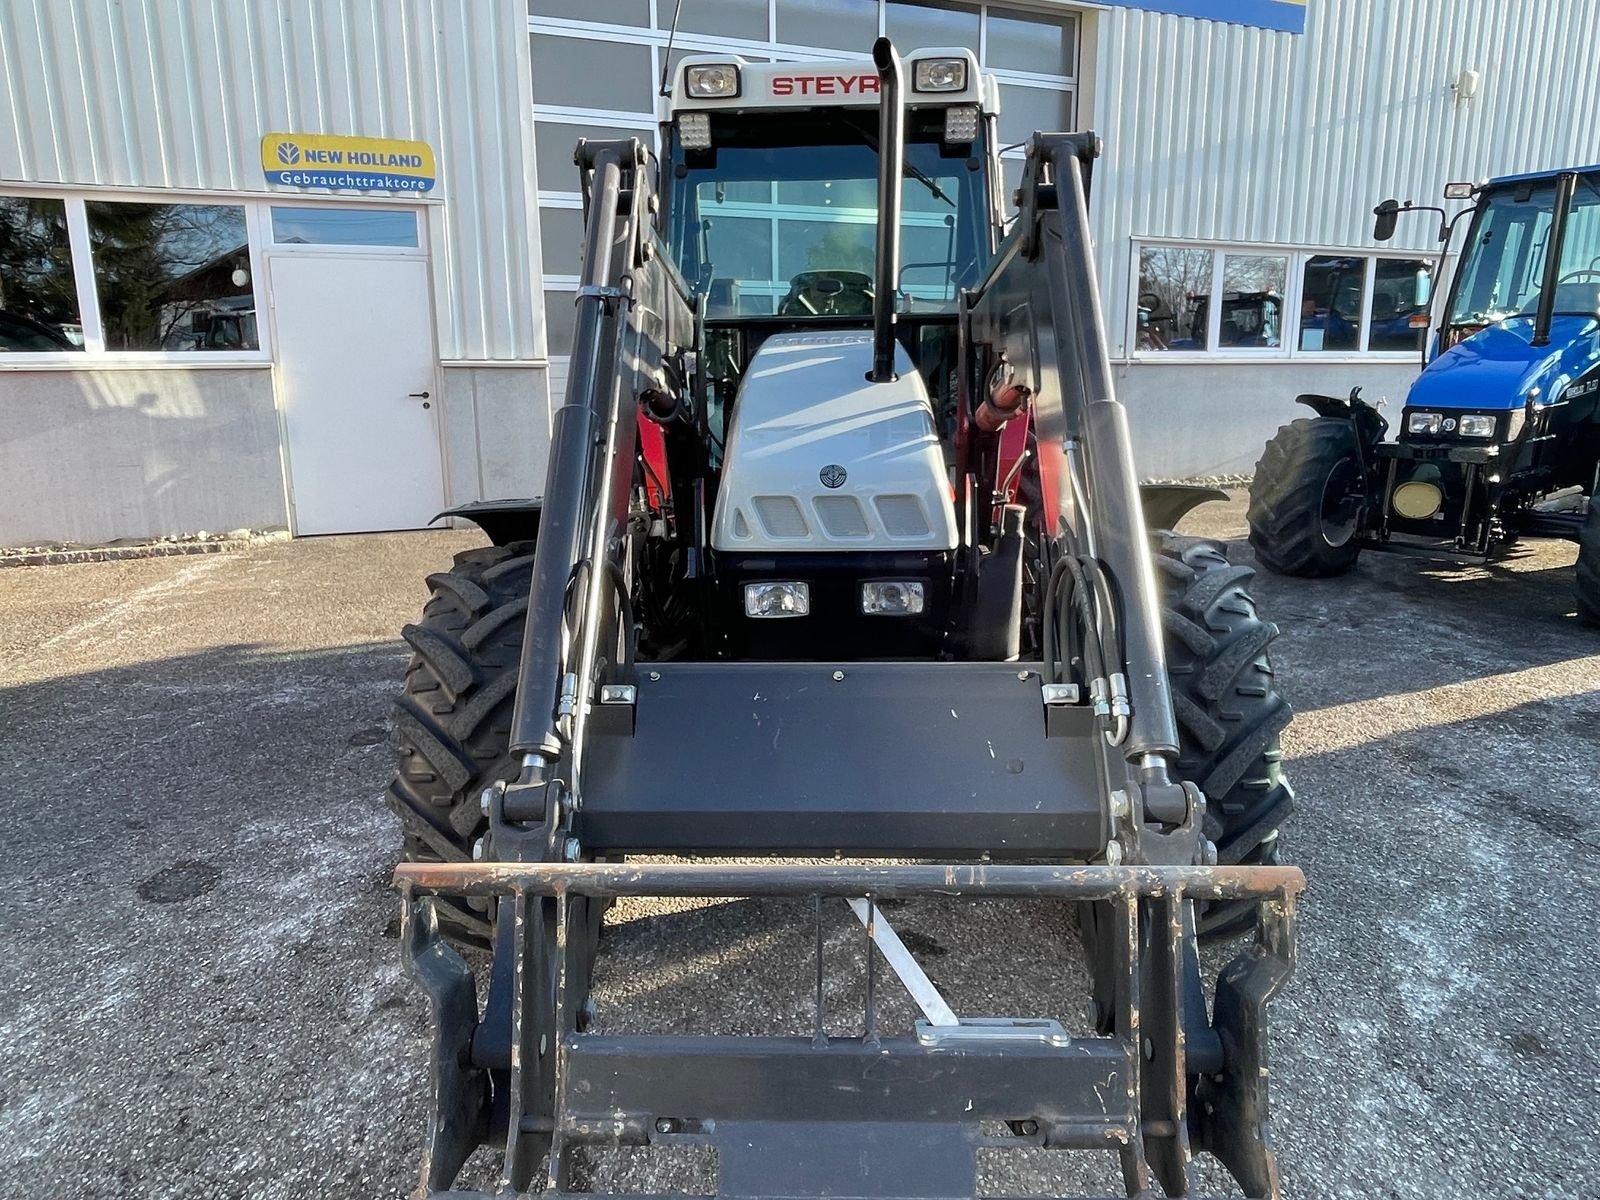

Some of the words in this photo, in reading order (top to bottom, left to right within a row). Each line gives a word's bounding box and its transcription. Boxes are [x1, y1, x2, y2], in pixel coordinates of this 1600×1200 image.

[772, 75, 880, 96] STEYR
[304, 149, 343, 165] NEW
[347, 151, 423, 168] HOLLAND
[280, 171, 426, 190] Gebrauchttraktore
